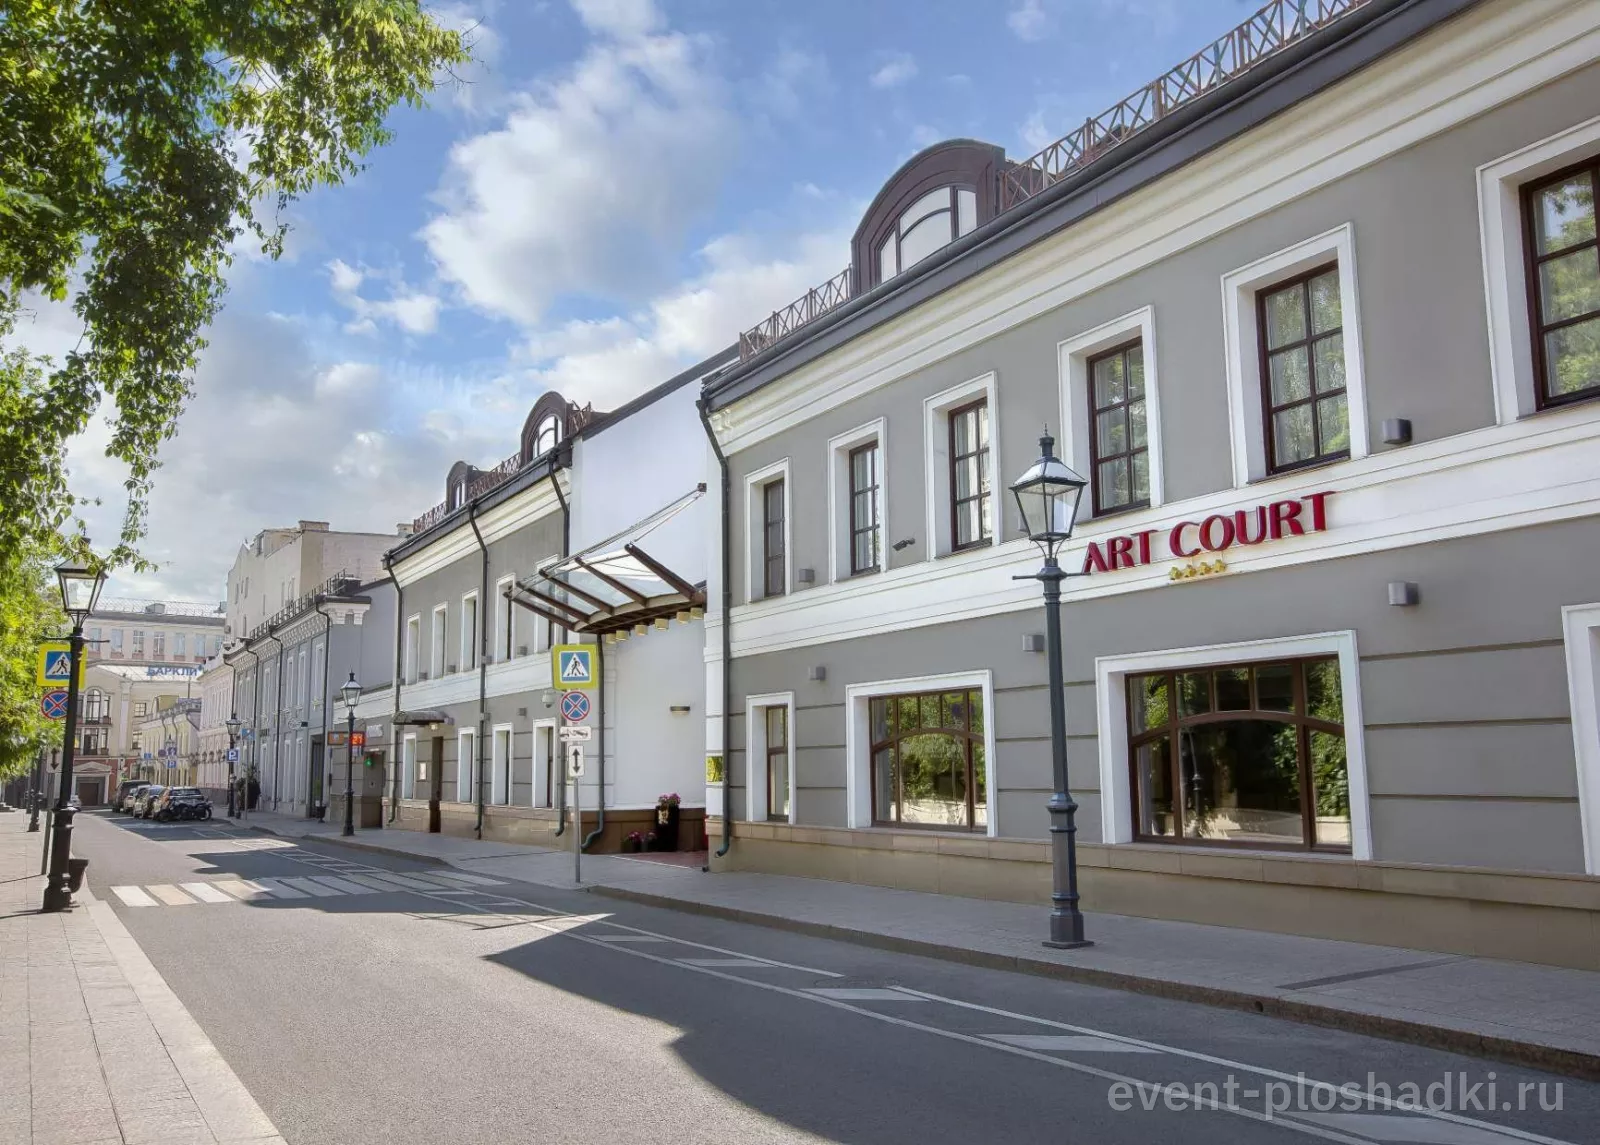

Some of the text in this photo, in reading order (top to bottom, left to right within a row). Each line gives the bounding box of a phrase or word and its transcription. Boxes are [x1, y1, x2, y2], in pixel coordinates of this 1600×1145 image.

[1081, 490, 1337, 575] ART COURT
[147, 666, 197, 677] БАРКЛИ
